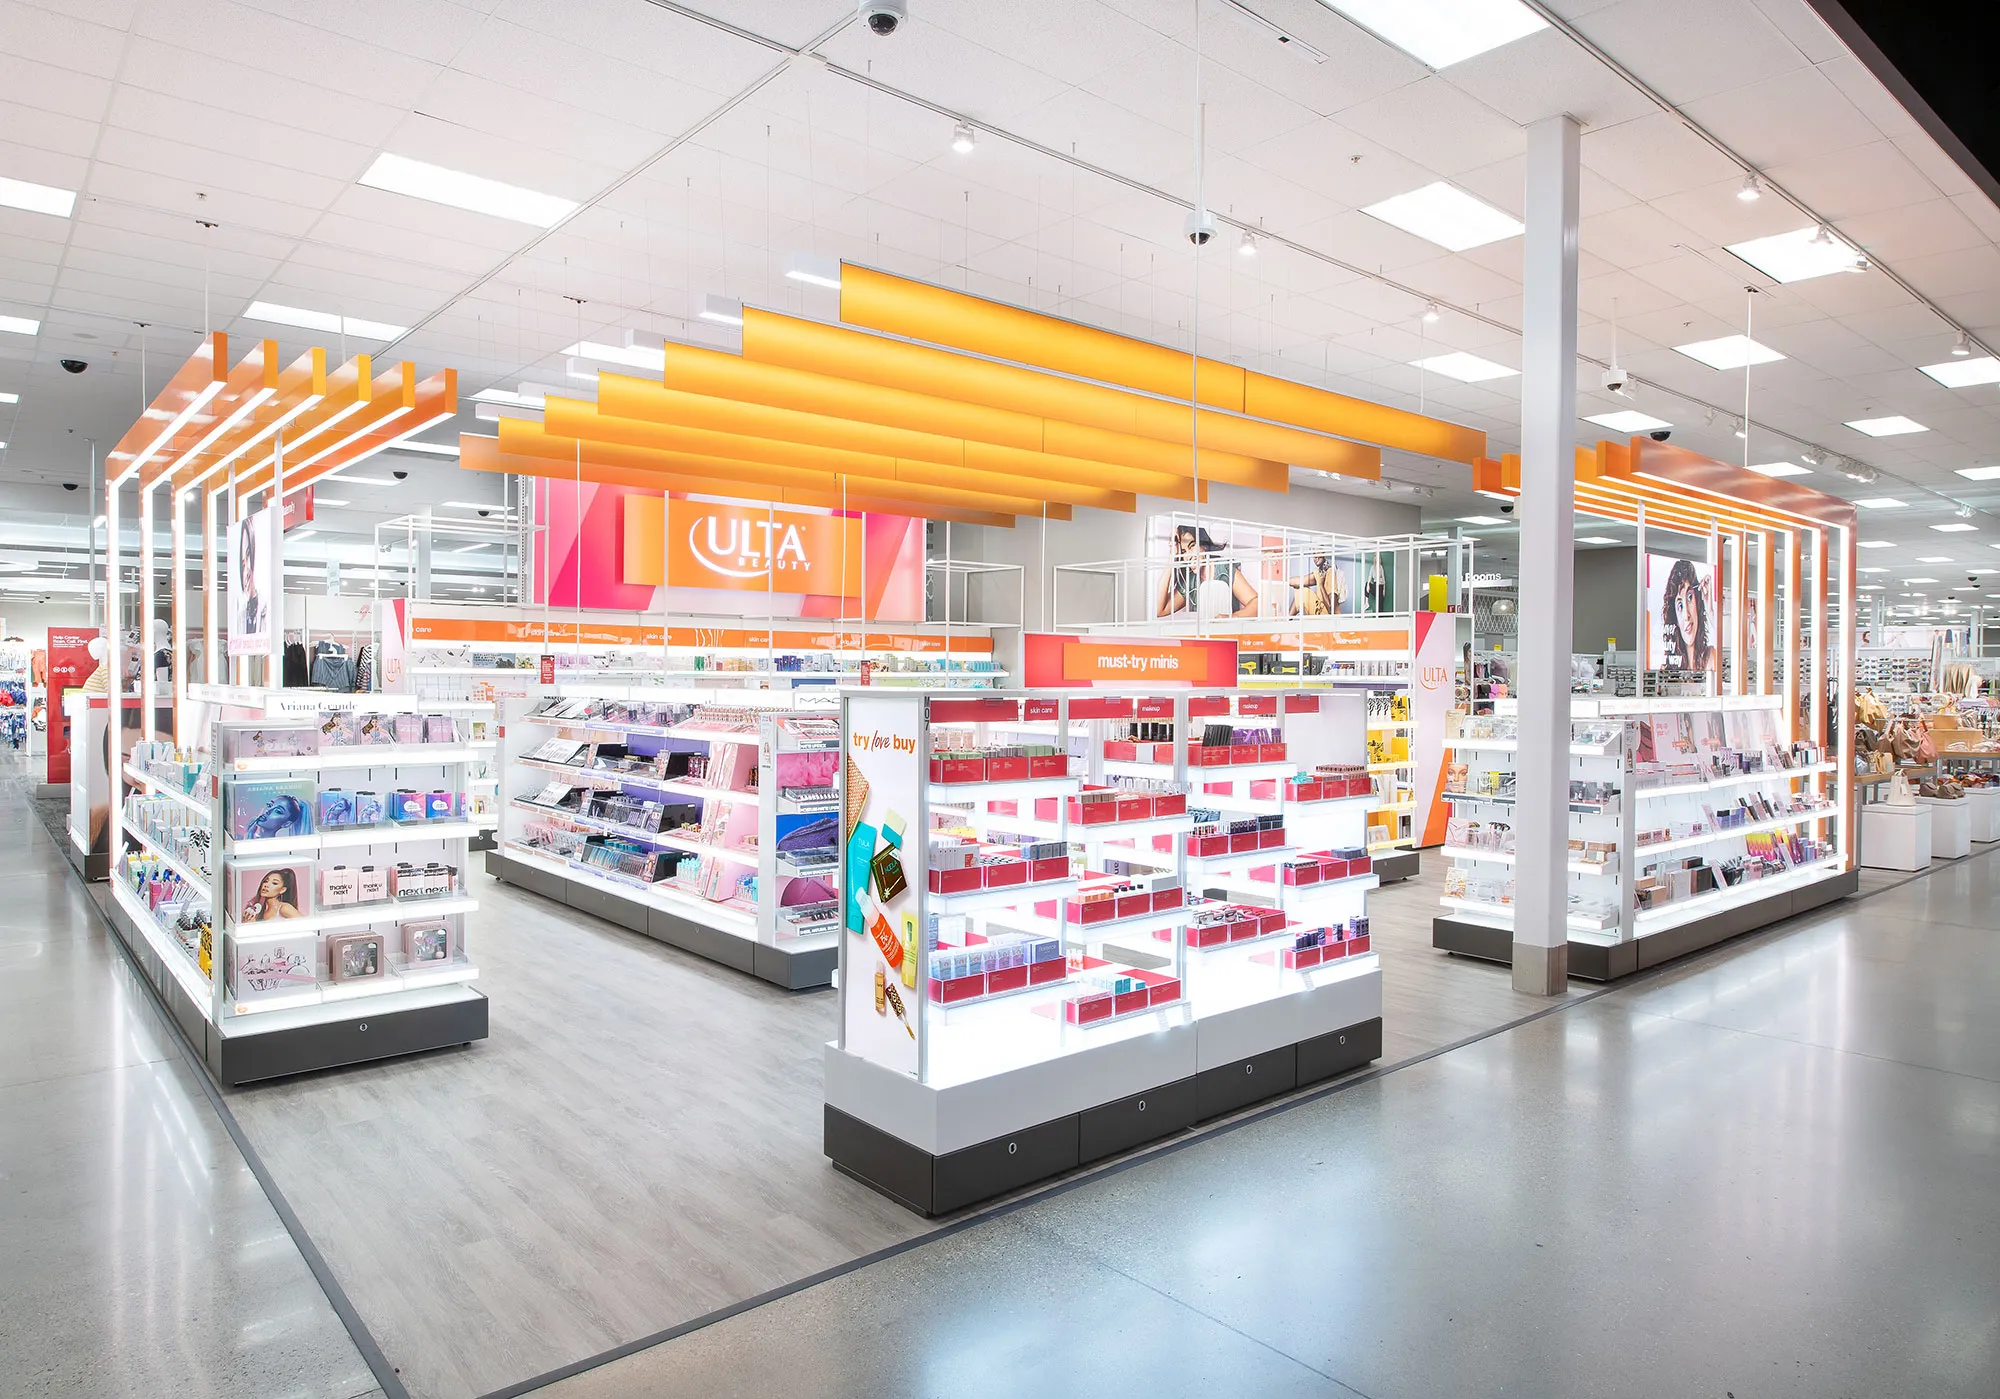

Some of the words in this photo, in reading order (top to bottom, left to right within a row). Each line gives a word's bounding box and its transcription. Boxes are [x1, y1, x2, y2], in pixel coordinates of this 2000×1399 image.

[708, 516, 807, 561] ULTA
[738, 556, 811, 571] BEAUTY
[1097, 654, 1148, 672] must-try
[1150, 654, 1179, 669] minis
[1423, 667, 1448, 682] ULTA
[280, 702, 316, 712] Ariana
[318, 701, 358, 712] Grande
[1030, 706, 1041, 714] skin
[1141, 705, 1160, 713] makeup
[853, 732, 870, 750] try
[871, 730, 891, 752] love
[893, 734, 916, 754] buy
[329, 883, 348, 891] thank
[399, 887, 424, 897] next
[425, 885, 449, 895] next
